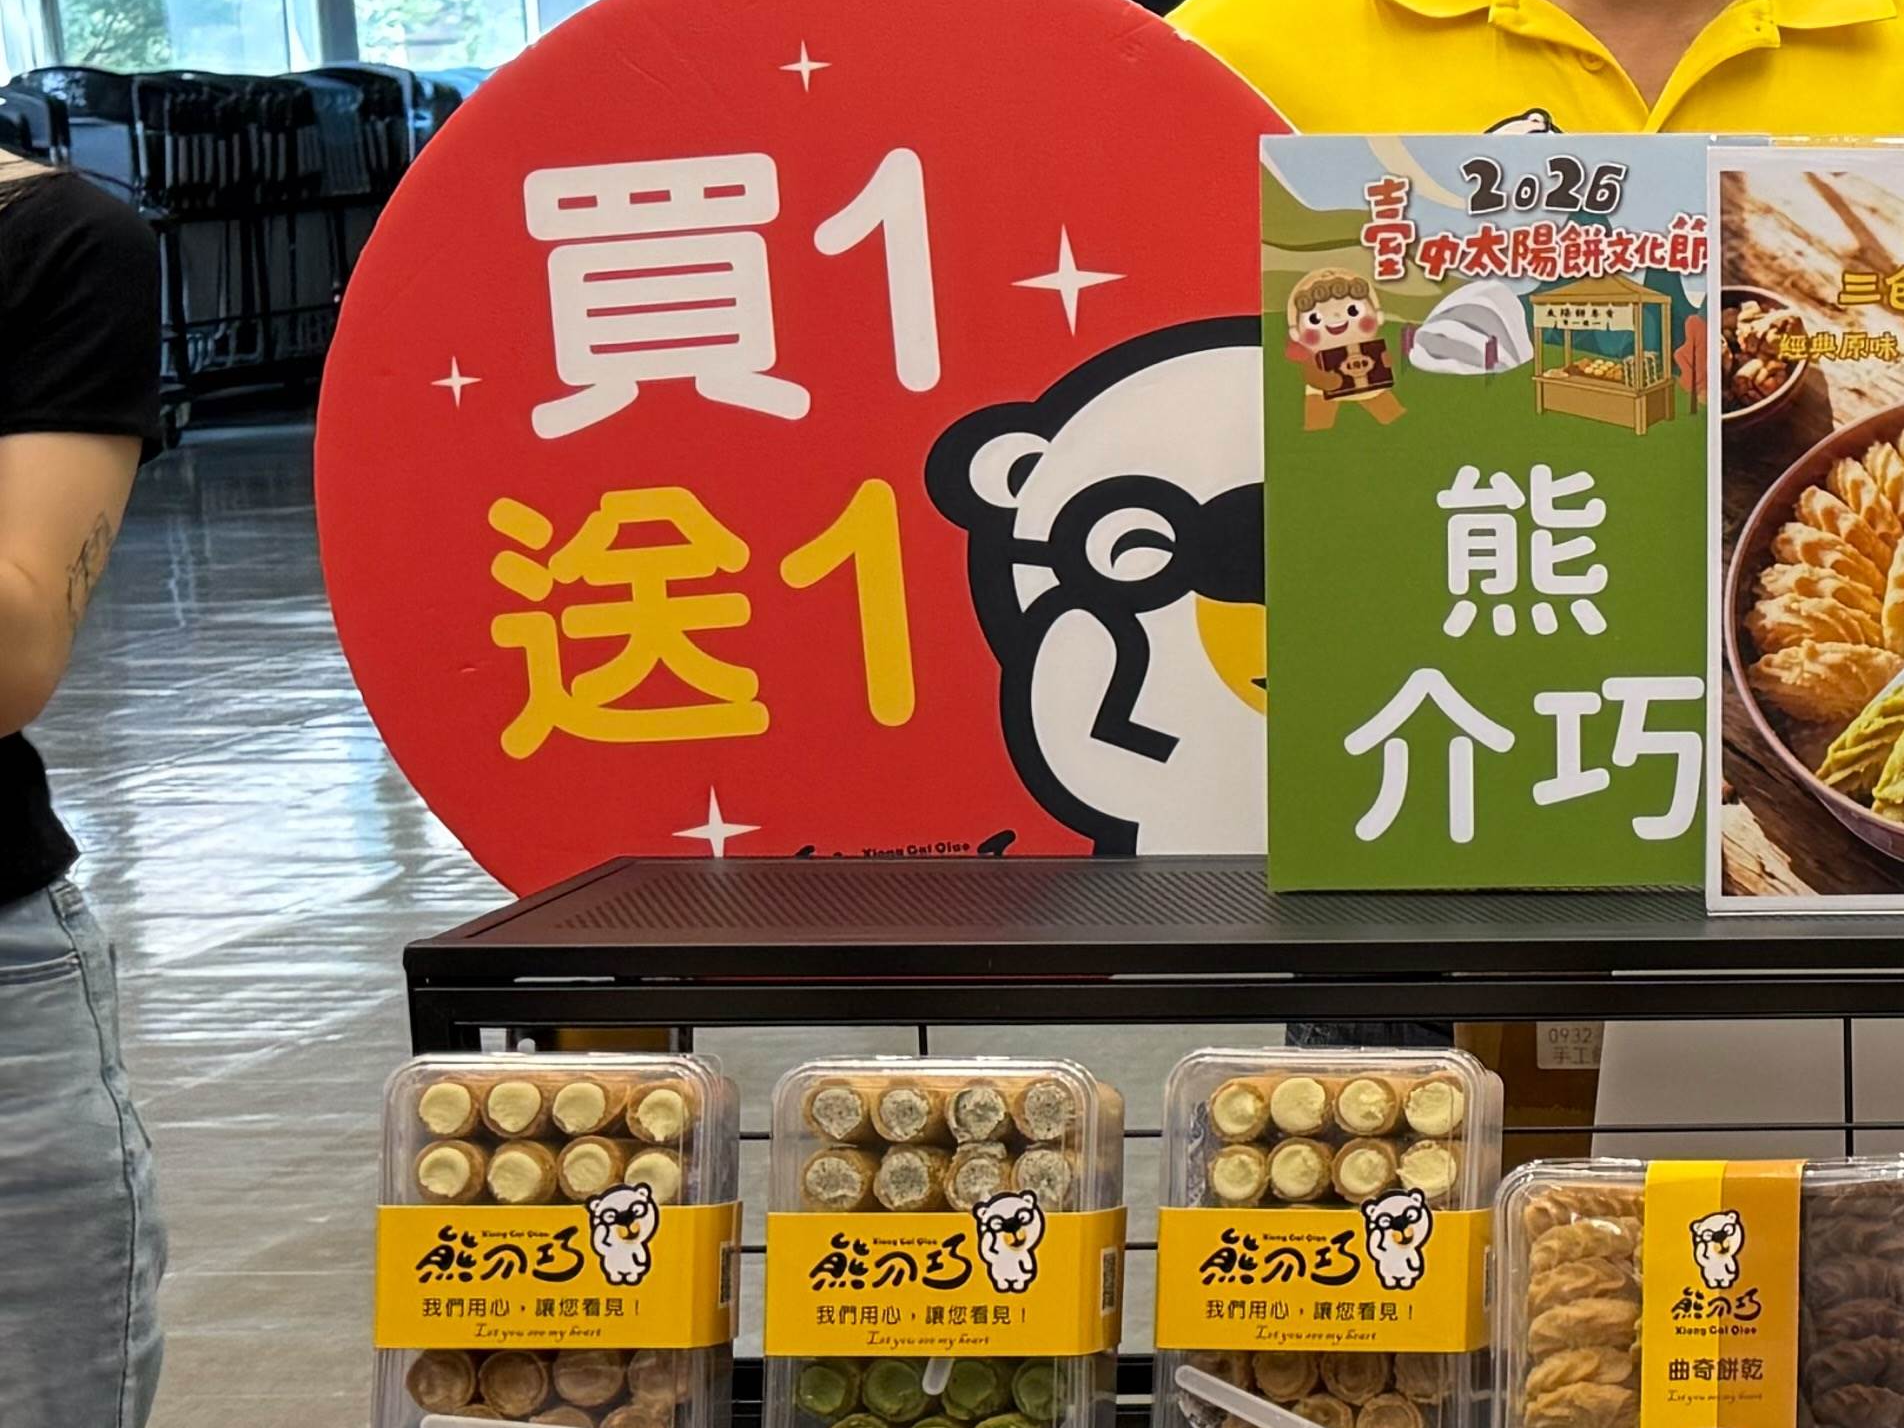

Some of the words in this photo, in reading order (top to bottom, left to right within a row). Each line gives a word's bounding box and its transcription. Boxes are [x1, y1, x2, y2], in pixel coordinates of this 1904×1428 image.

[1361, 175, 1708, 283] 臺中太陽餅文化節
[1460, 156, 1629, 215] 2026
[523, 147, 942, 440] 買1
[1778, 332, 1898, 361] 經典原味
[487, 477, 915, 760] 送1
[1437, 464, 1608, 637] 熊
[1343, 667, 1705, 843] 介巧
[1669, 1357, 1764, 1382] 曲奇餅乾
